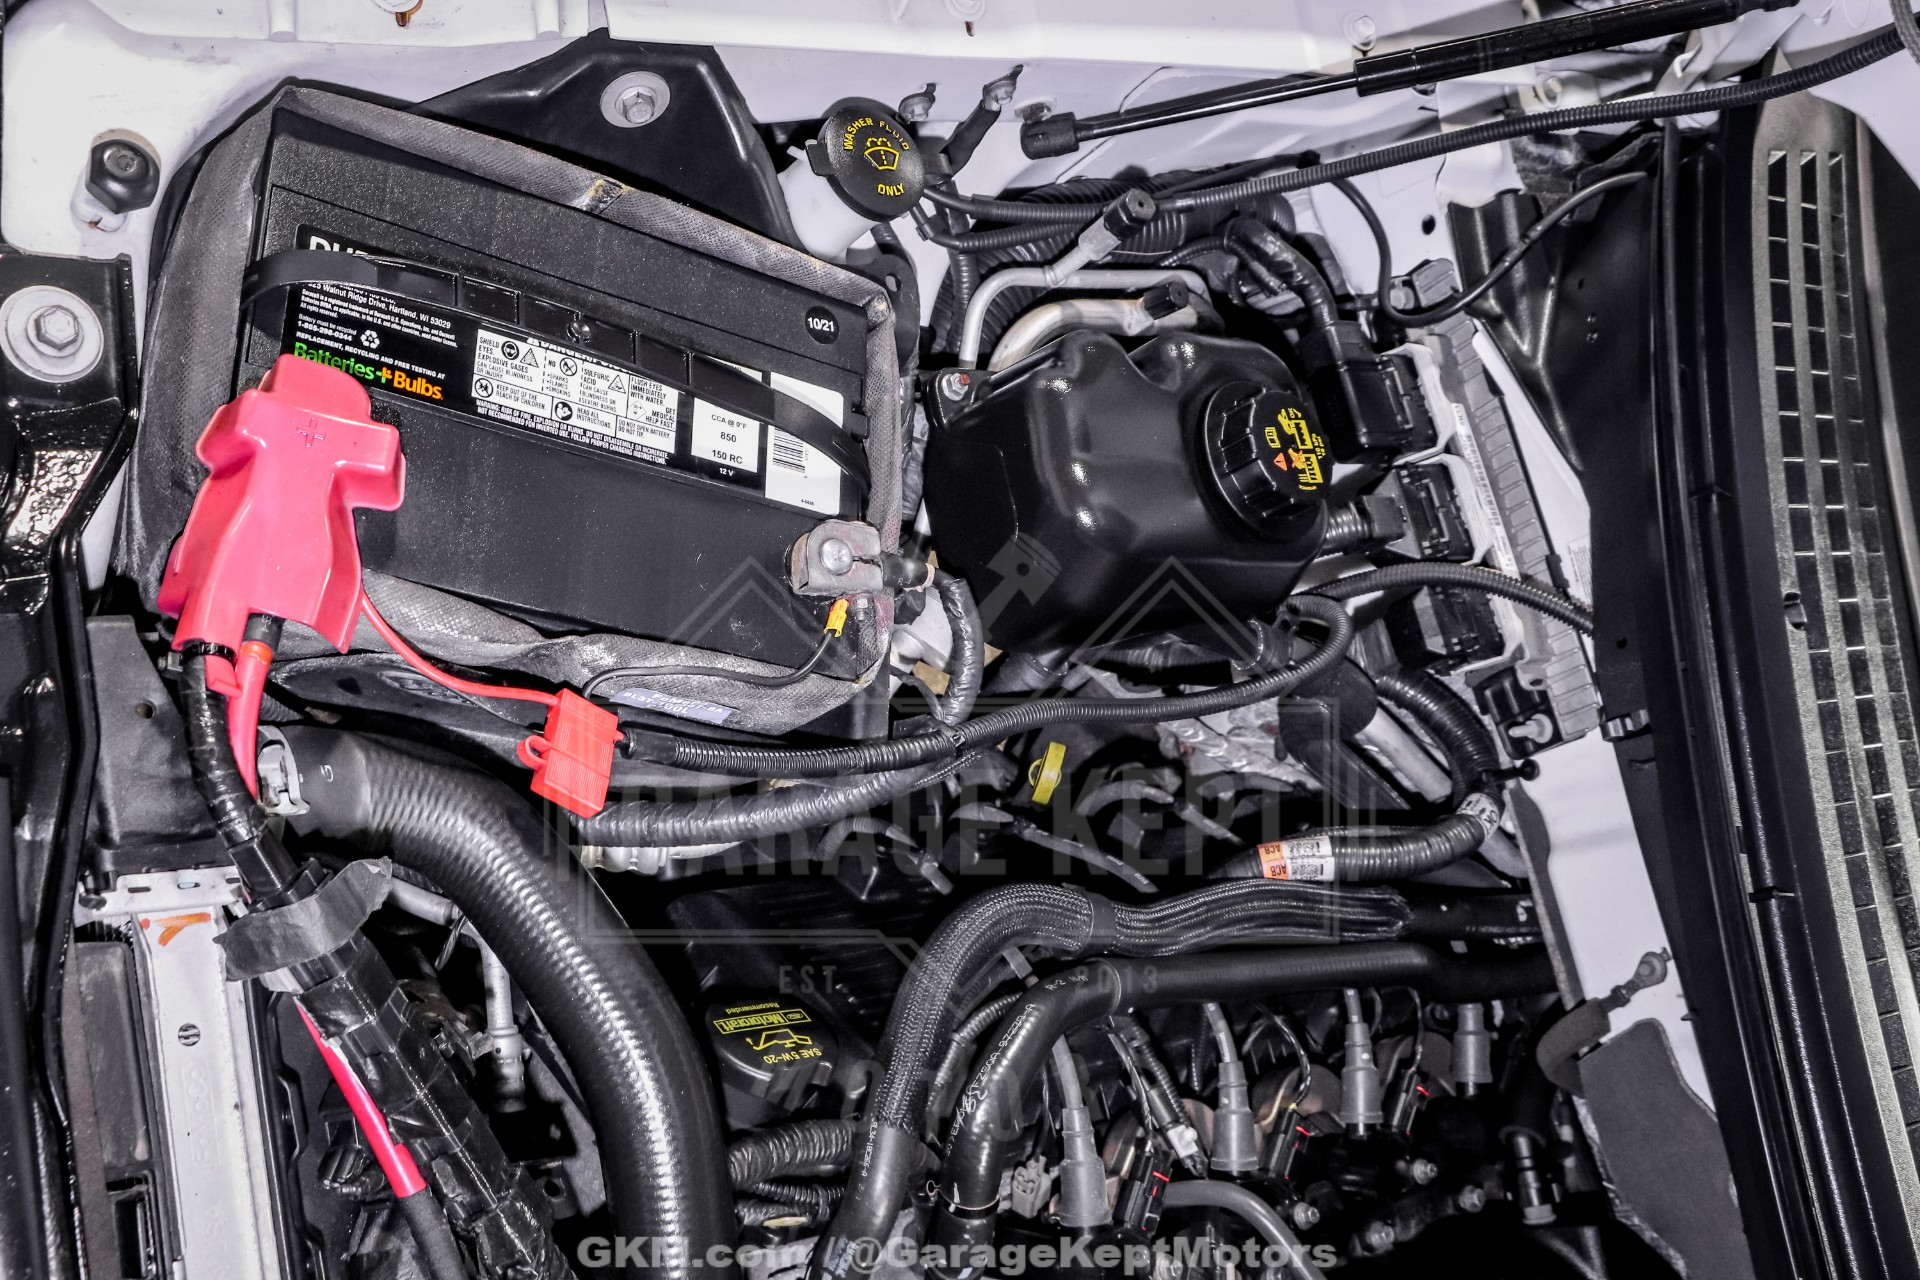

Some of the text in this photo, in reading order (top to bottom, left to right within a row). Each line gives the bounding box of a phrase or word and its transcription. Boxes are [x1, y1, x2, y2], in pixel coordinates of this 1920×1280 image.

[844, 118, 910, 150] WASHER FLUID
[878, 183, 904, 196] ONLY
[323, 284, 346, 297] Walnut
[348, 291, 367, 304] Ridge
[368, 298, 387, 310] Drive,
[389, 304, 418, 320] Hartland,
[420, 313, 429, 322] WI
[430, 317, 451, 329] 53029
[299, 314, 316, 324] Battery
[808, 316, 834, 332] 10/21
[480, 337, 499, 348] SHIELD
[296, 331, 344, 350] REPLACEMENT,
[345, 346, 379, 360] RECYCLING
[380, 356, 393, 364] AND
[394, 360, 410, 370] FREE
[411, 364, 436, 377] TESTING
[478, 353, 528, 373] EXPLOSIVE GASES
[485, 368, 503, 379] INJURY
[489, 364, 503, 373] CAUSE
[506, 369, 532, 382] BLINDNESS
[584, 369, 610, 381] SULFURIC
[584, 377, 596, 385] ACID
[631, 377, 662, 392] FLUSH EYES
[496, 391, 512, 400] REACH
[528, 392, 537, 401] THE
[594, 387, 608, 396] CAUSE
[631, 384, 666, 399] IMMEDIATELY
[476, 399, 500, 409] WARNING:
[582, 393, 608, 403] BLINDNESS
[630, 391, 665, 406] WITH WATER.
[577, 407, 590, 415] READ
[652, 410, 675, 422] MEDICAL
[646, 416, 674, 429] HELP FAST.
[712, 414, 726, 424] CCA
[488, 410, 525, 425] RECOMMENDED
[571, 434, 590, 444] FOLLOW
[626, 421, 636, 429] NOT
[637, 424, 649, 433] OPEN
[720, 432, 737, 443] 850
[712, 450, 742, 464] 150 RC
[726, 1003, 780, 1015] Recommended
[718, 1013, 784, 1031] Motorcraft
[764, 1048, 822, 1064] SAE 5W-20
